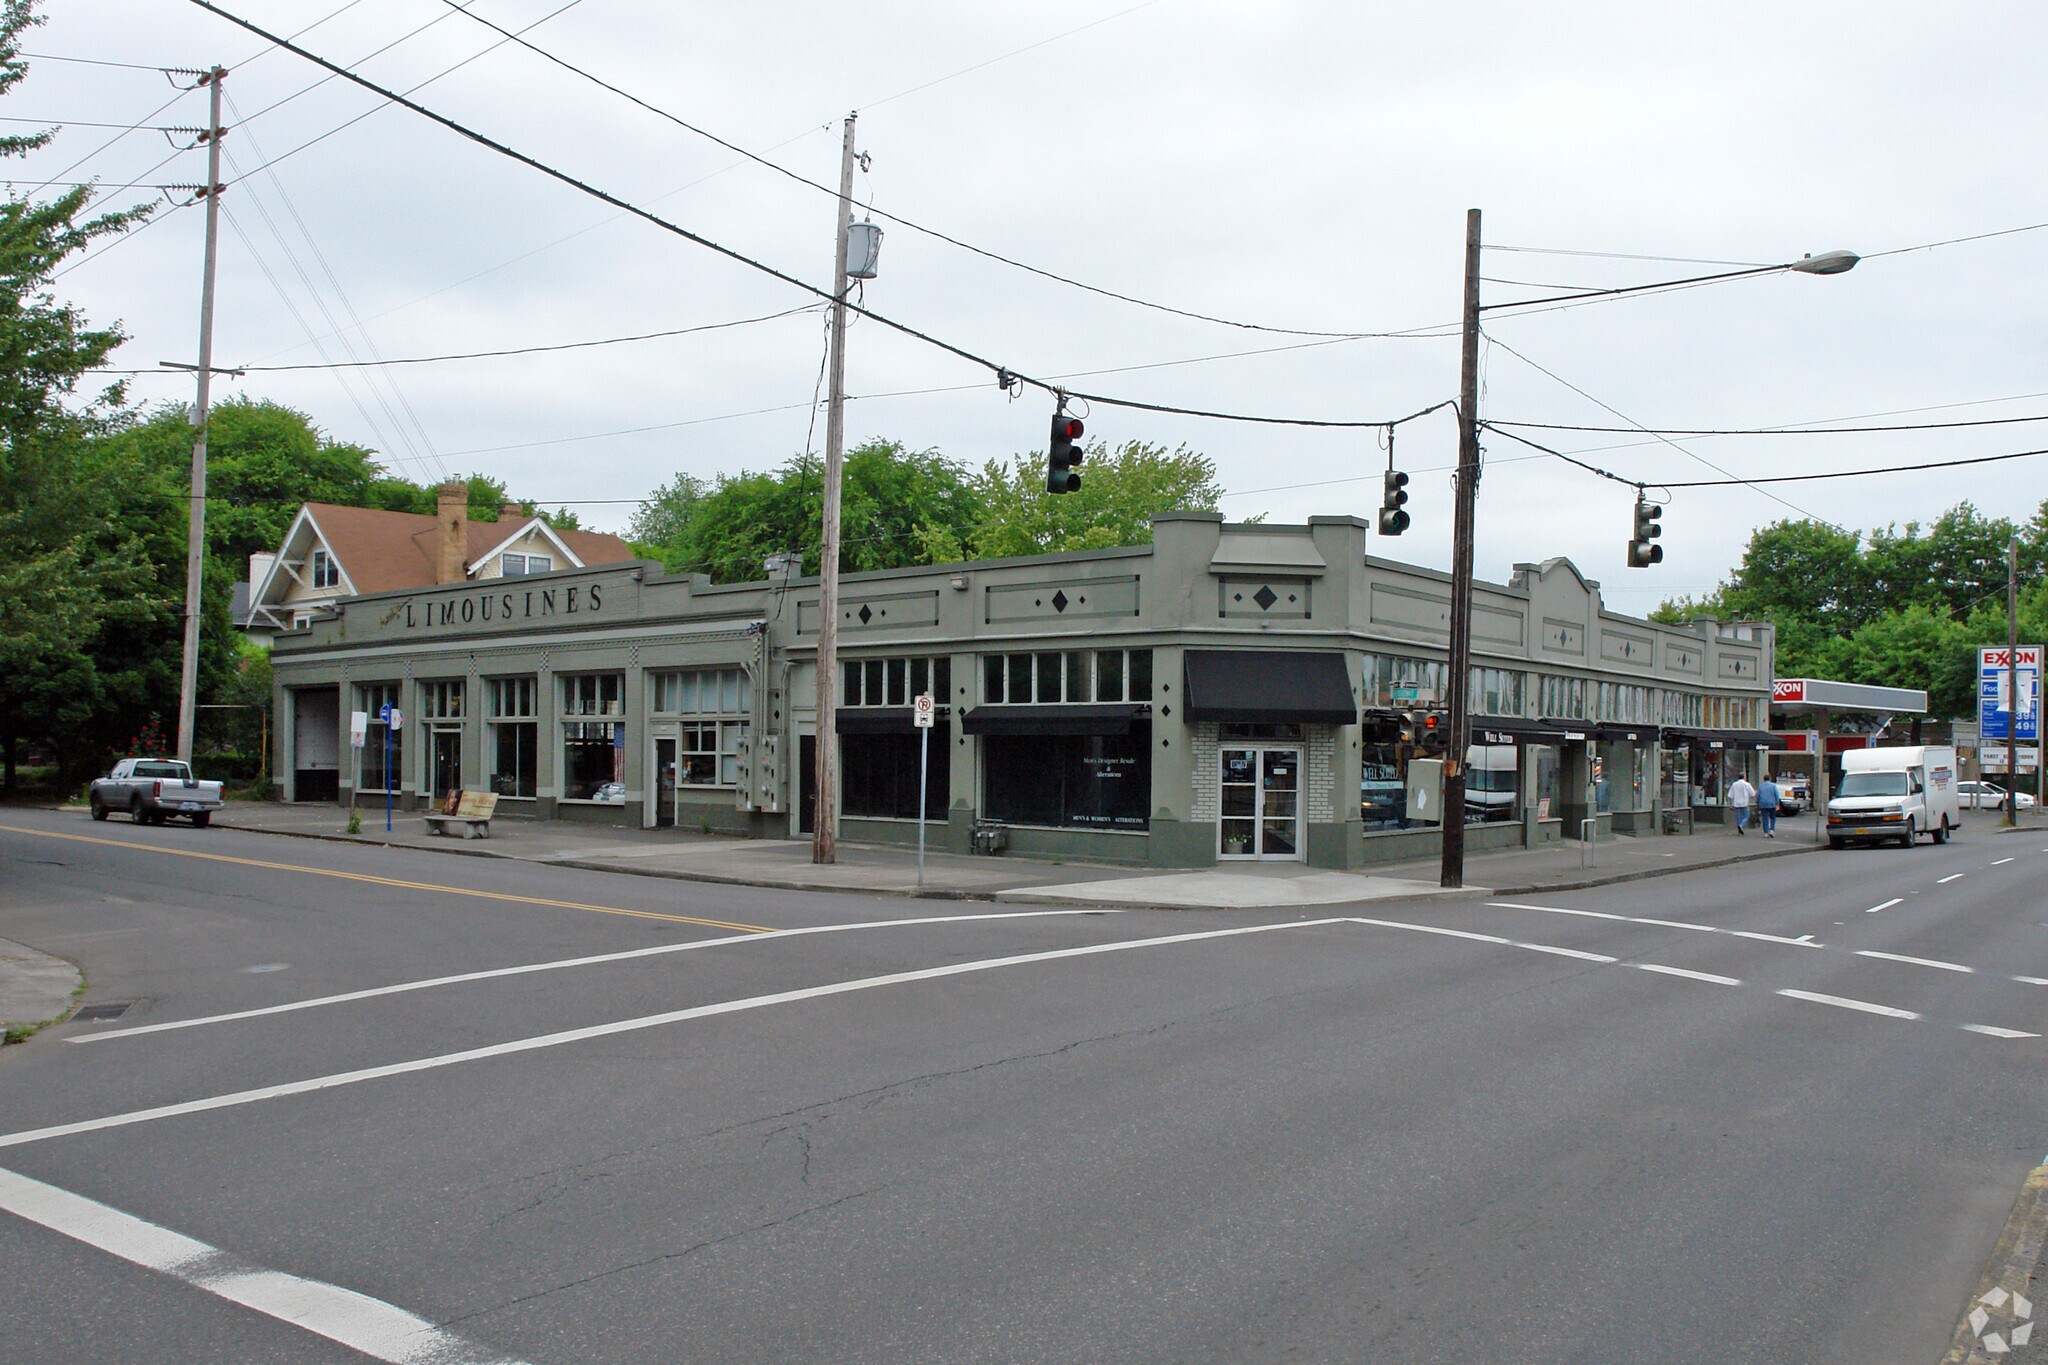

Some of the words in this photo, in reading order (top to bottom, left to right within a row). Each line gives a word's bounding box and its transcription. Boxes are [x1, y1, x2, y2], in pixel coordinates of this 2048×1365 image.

[407, 584, 602, 628] LIMOUSINES
[1984, 651, 2035, 667] EXXON
[1773, 682, 1801, 696] XXON
